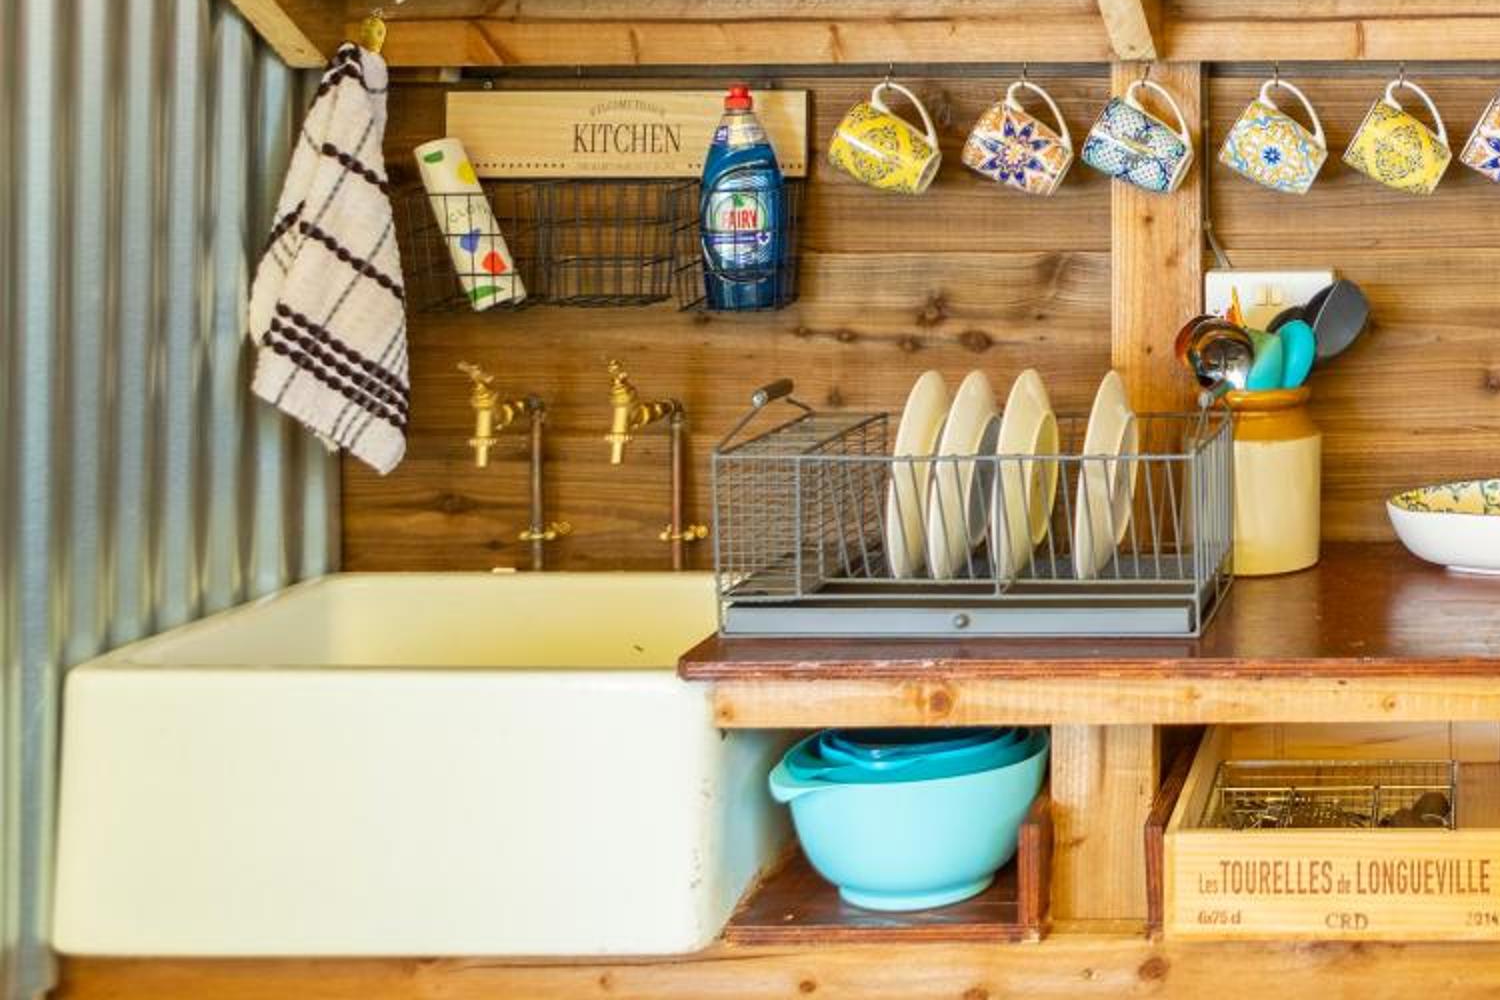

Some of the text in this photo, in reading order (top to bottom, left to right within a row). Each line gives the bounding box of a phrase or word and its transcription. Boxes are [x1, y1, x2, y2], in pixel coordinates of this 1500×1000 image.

[573, 123, 682, 153] KITCHEN
[722, 210, 757, 229] FAIRY
[1198, 859, 1492, 896] Les TOURELLES de LONGUEVILLE
[1324, 912, 1369, 931] CRD
